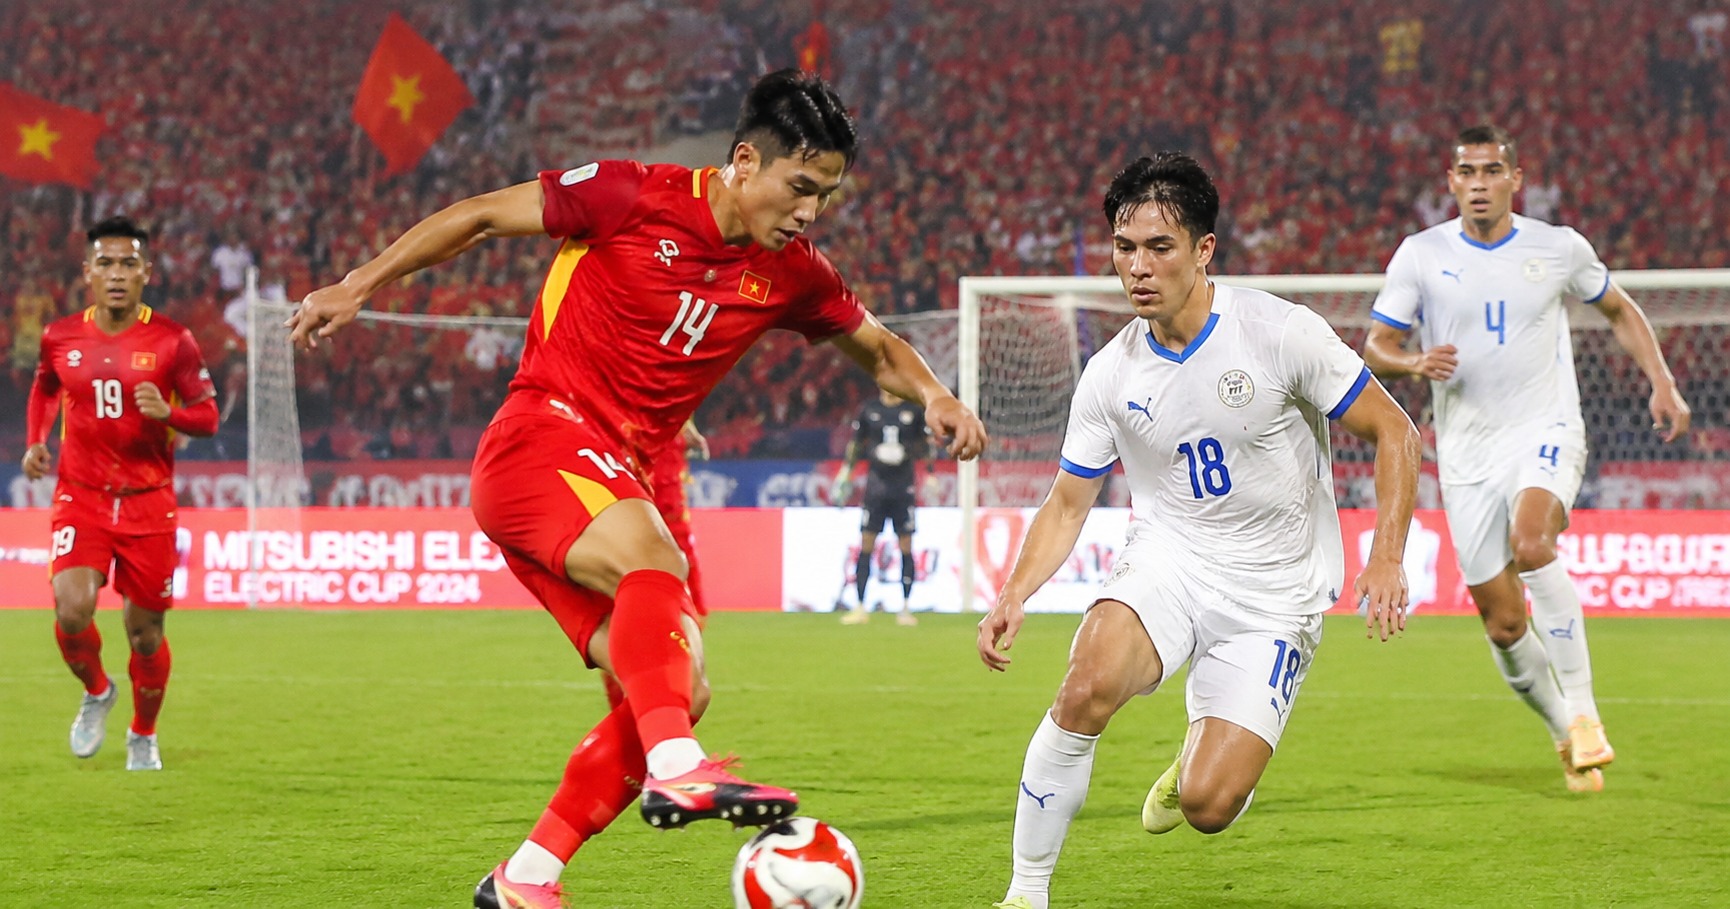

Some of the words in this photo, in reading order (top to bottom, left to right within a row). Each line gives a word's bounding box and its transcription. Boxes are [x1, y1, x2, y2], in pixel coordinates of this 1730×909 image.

[659, 290, 719, 356] 14
[1485, 300, 1505, 345] 4
[91, 378, 124, 419] 19
[1177, 437, 1232, 499] 18
[1538, 444, 1560, 467] 4
[52, 525, 76, 562] 19
[203, 530, 416, 571] MITSUBISHI
[422, 530, 507, 572] ELE
[203, 571, 345, 603] ELECTRIC
[348, 571, 413, 603] CUP
[416, 572, 482, 603] 2024
[1268, 639, 1301, 706] 18
